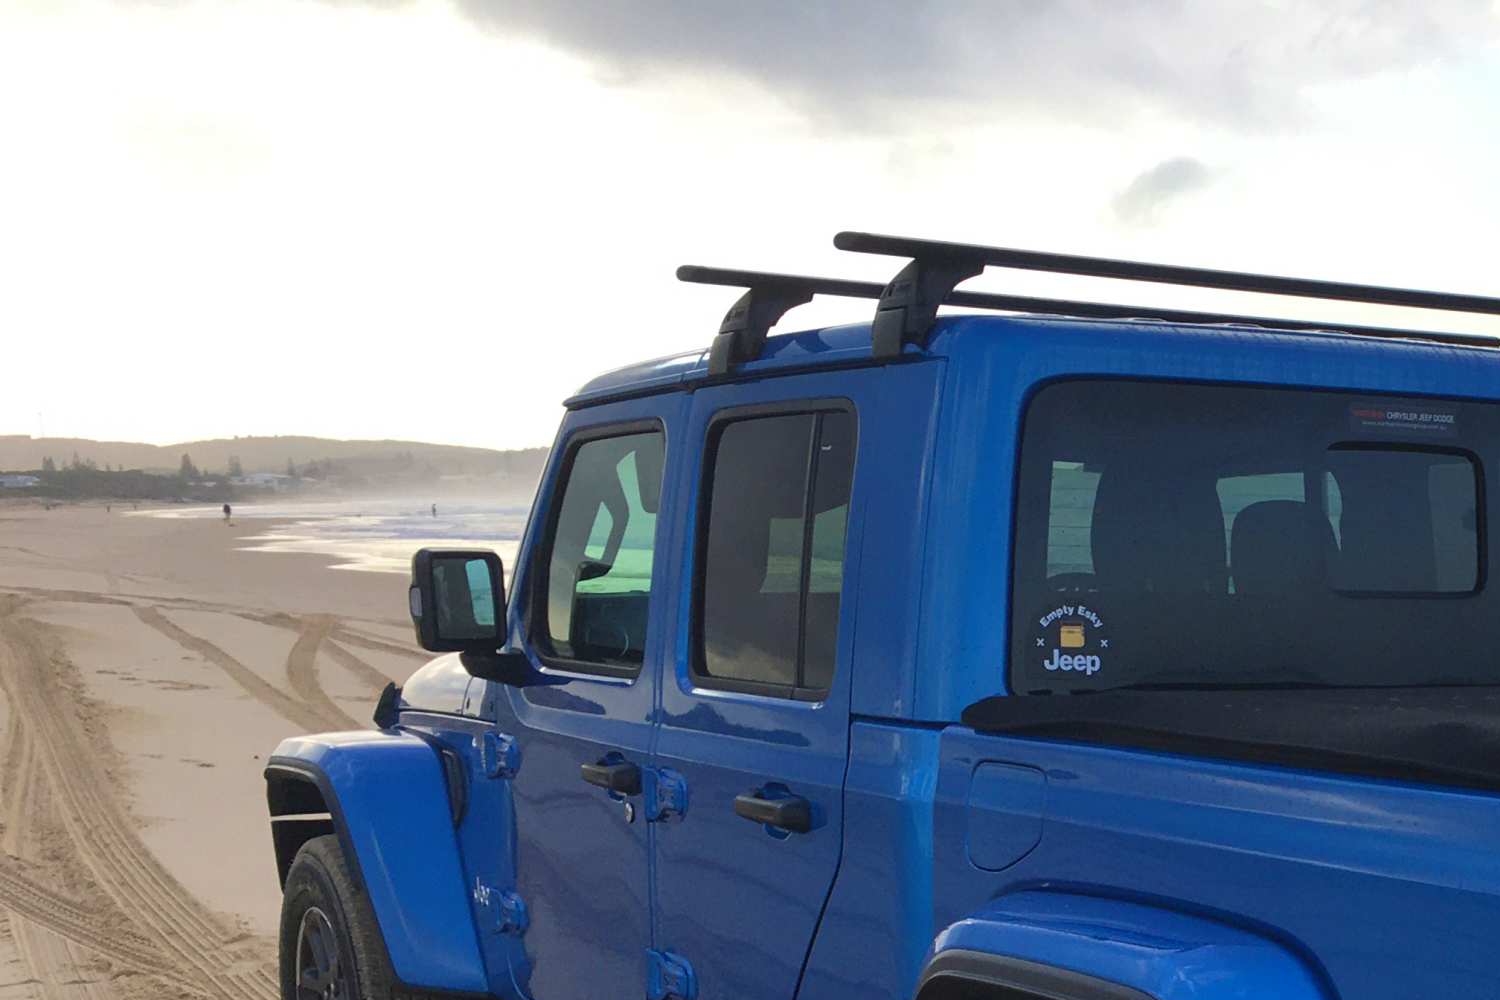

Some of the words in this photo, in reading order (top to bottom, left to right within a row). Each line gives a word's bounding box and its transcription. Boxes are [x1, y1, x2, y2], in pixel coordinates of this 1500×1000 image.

[1040, 605, 1075, 627] Empty
[1077, 605, 1103, 628] Esky
[1043, 649, 1101, 676] Jeep
